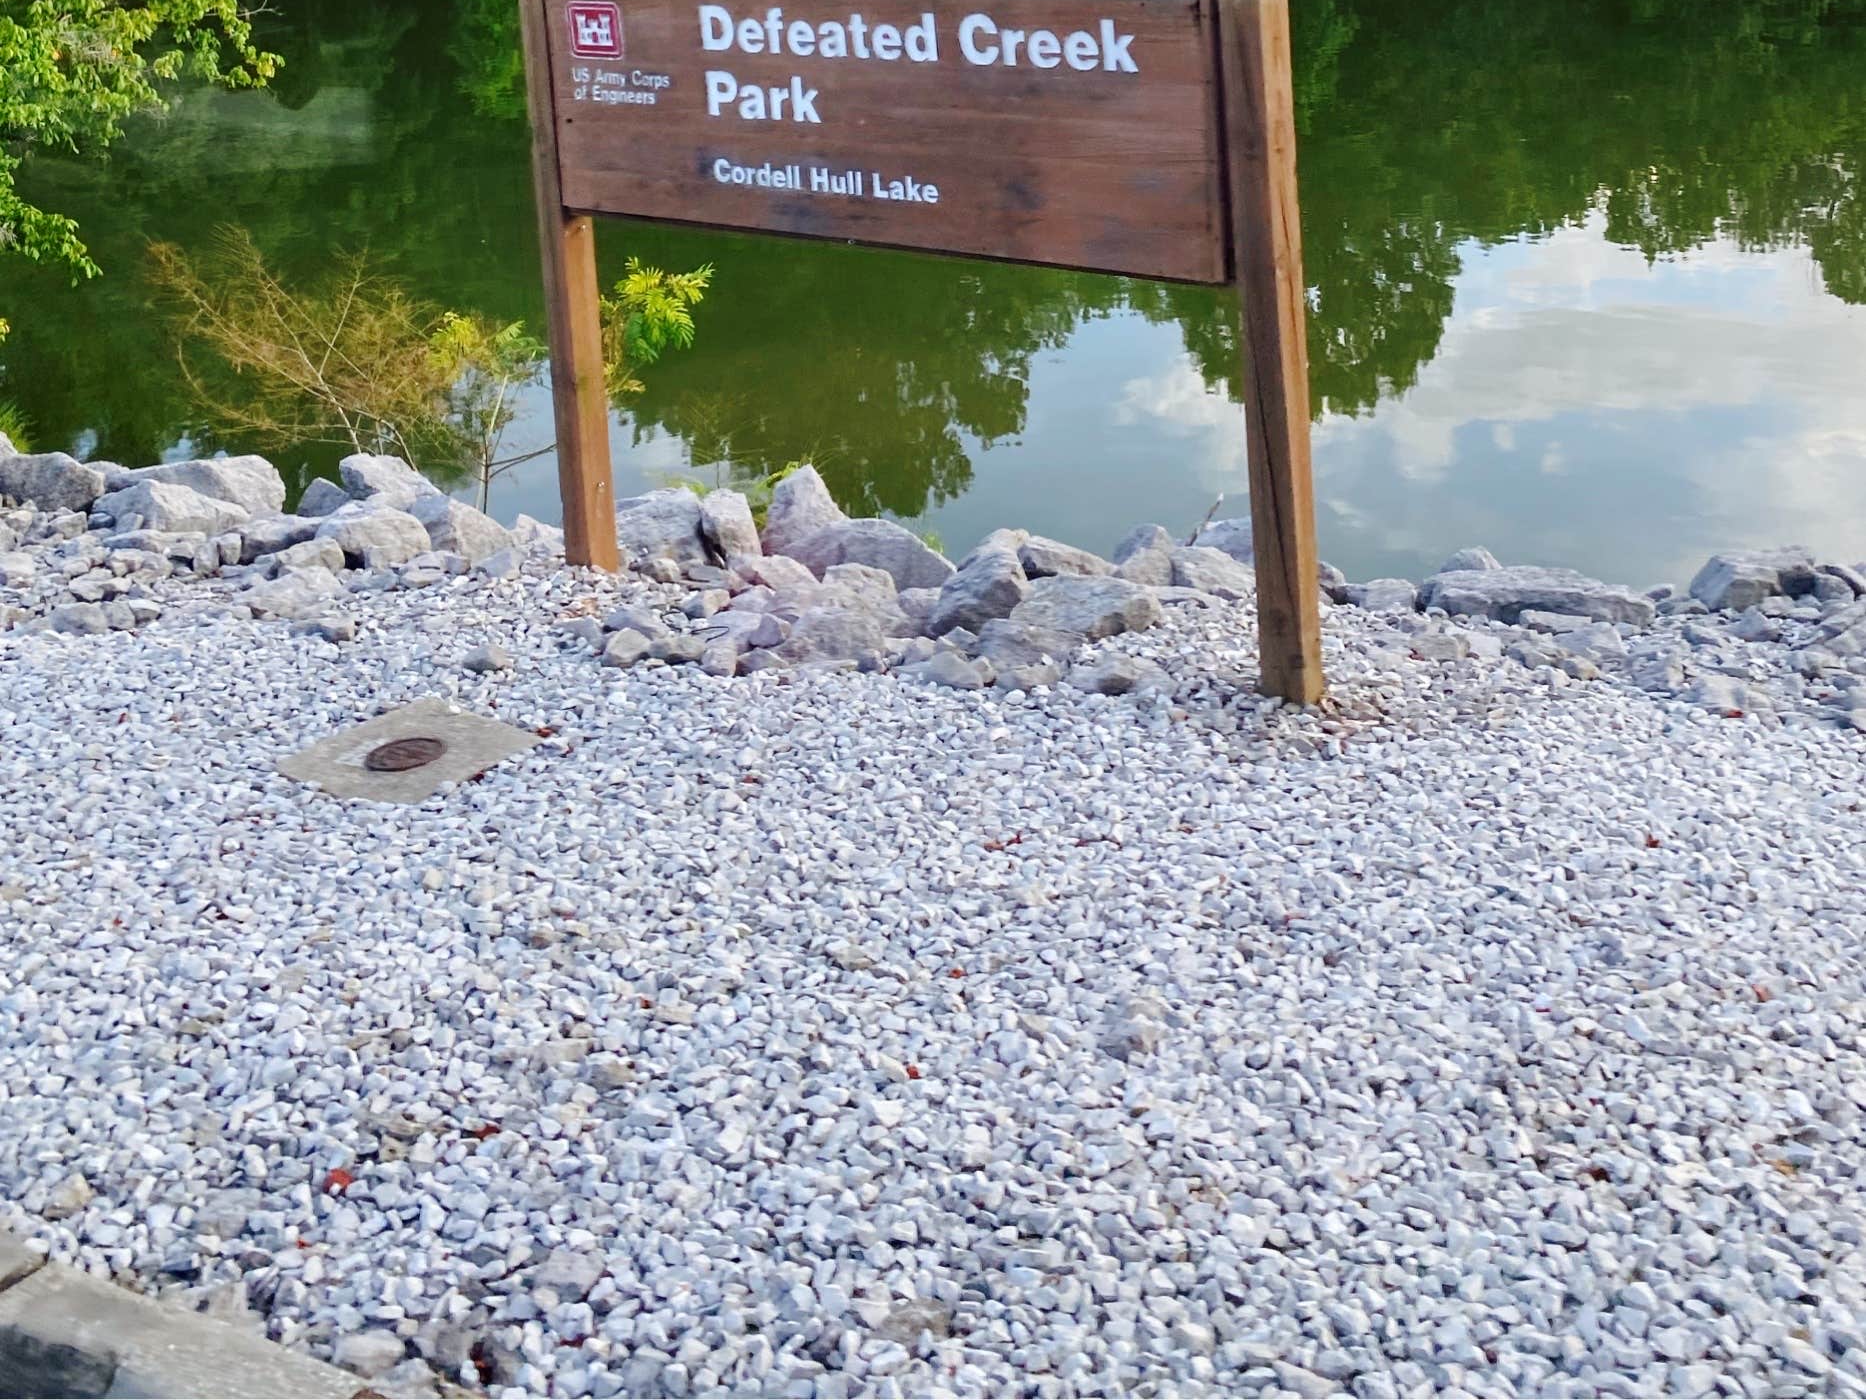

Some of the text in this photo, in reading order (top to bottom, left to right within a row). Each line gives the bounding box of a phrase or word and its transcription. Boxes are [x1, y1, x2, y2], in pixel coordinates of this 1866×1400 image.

[699, 4, 1139, 74] Defeated Creek
[572, 67, 671, 90] US Army Corps
[574, 84, 656, 105] of Engineers
[705, 70, 822, 124] Park
[713, 158, 939, 204] Cordell Hull Lake
